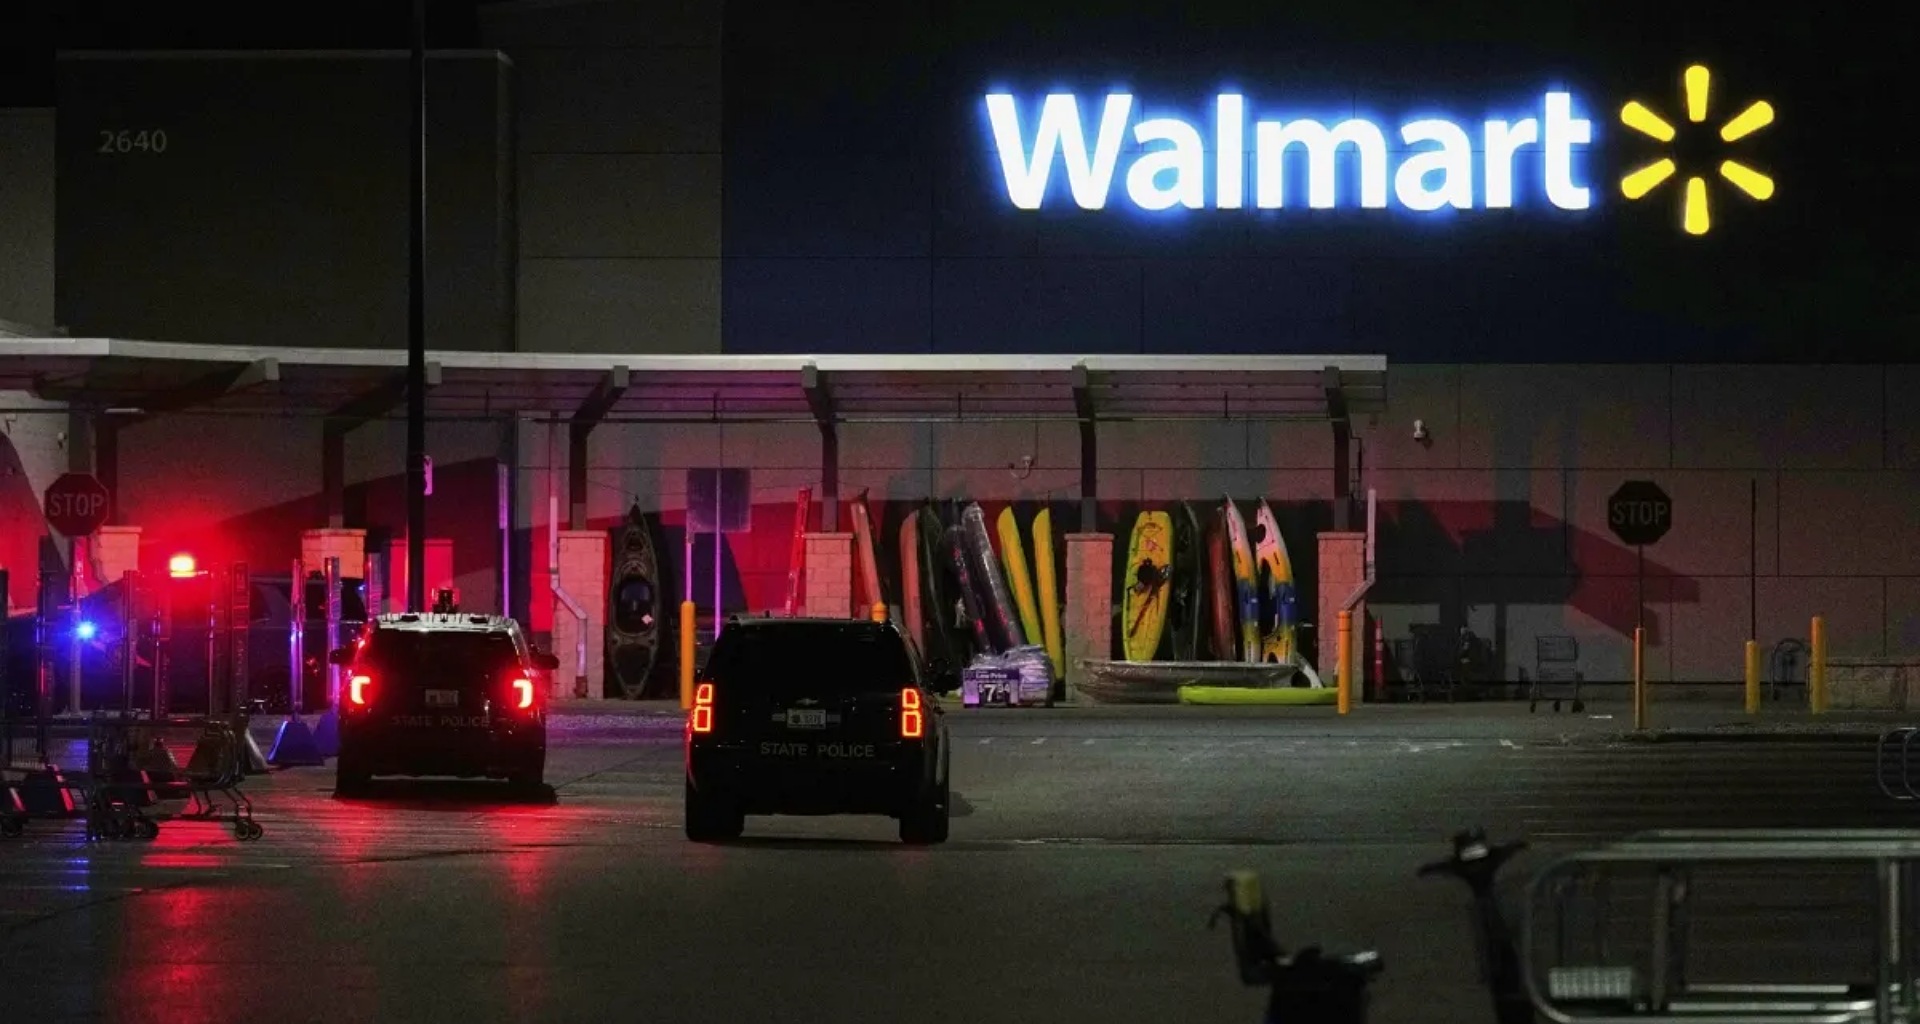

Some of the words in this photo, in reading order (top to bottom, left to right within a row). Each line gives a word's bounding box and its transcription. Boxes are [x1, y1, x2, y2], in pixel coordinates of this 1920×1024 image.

[97, 129, 168, 153] 2640
[985, 92, 1591, 211] Walmart
[48, 492, 105, 518] STOP
[1612, 500, 1668, 526] STOP
[390, 715, 433, 727] STATE
[440, 715, 490, 728] POLICE
[760, 741, 809, 756] STATE
[817, 743, 876, 758] POLICE
